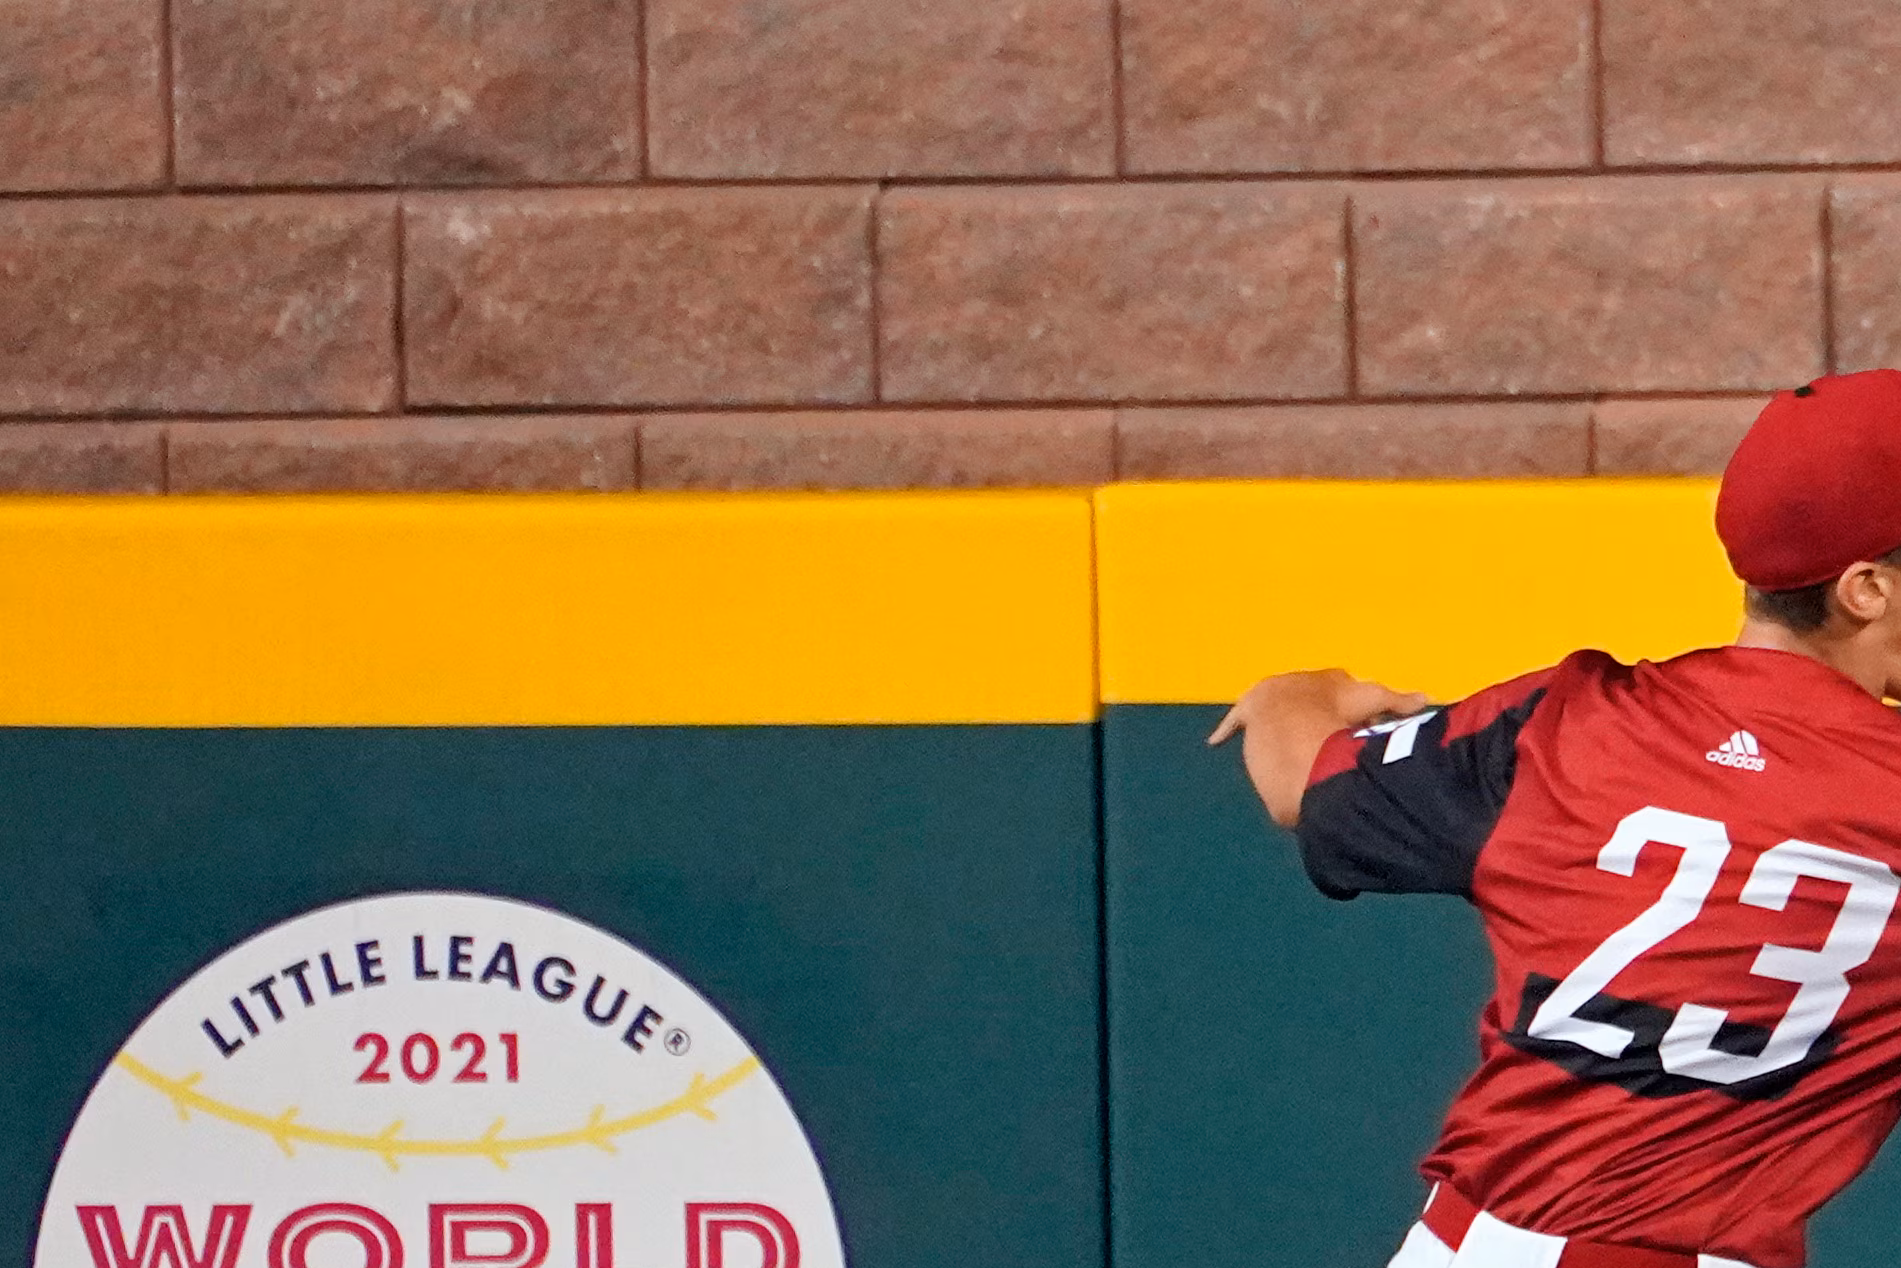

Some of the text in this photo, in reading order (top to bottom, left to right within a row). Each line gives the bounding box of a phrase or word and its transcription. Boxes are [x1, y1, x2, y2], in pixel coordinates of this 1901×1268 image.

[1705, 750, 1767, 772] adidas
[1527, 805, 1901, 1086] 23
[200, 938, 387, 1058] LITTLE
[353, 1031, 520, 1084] 2021
